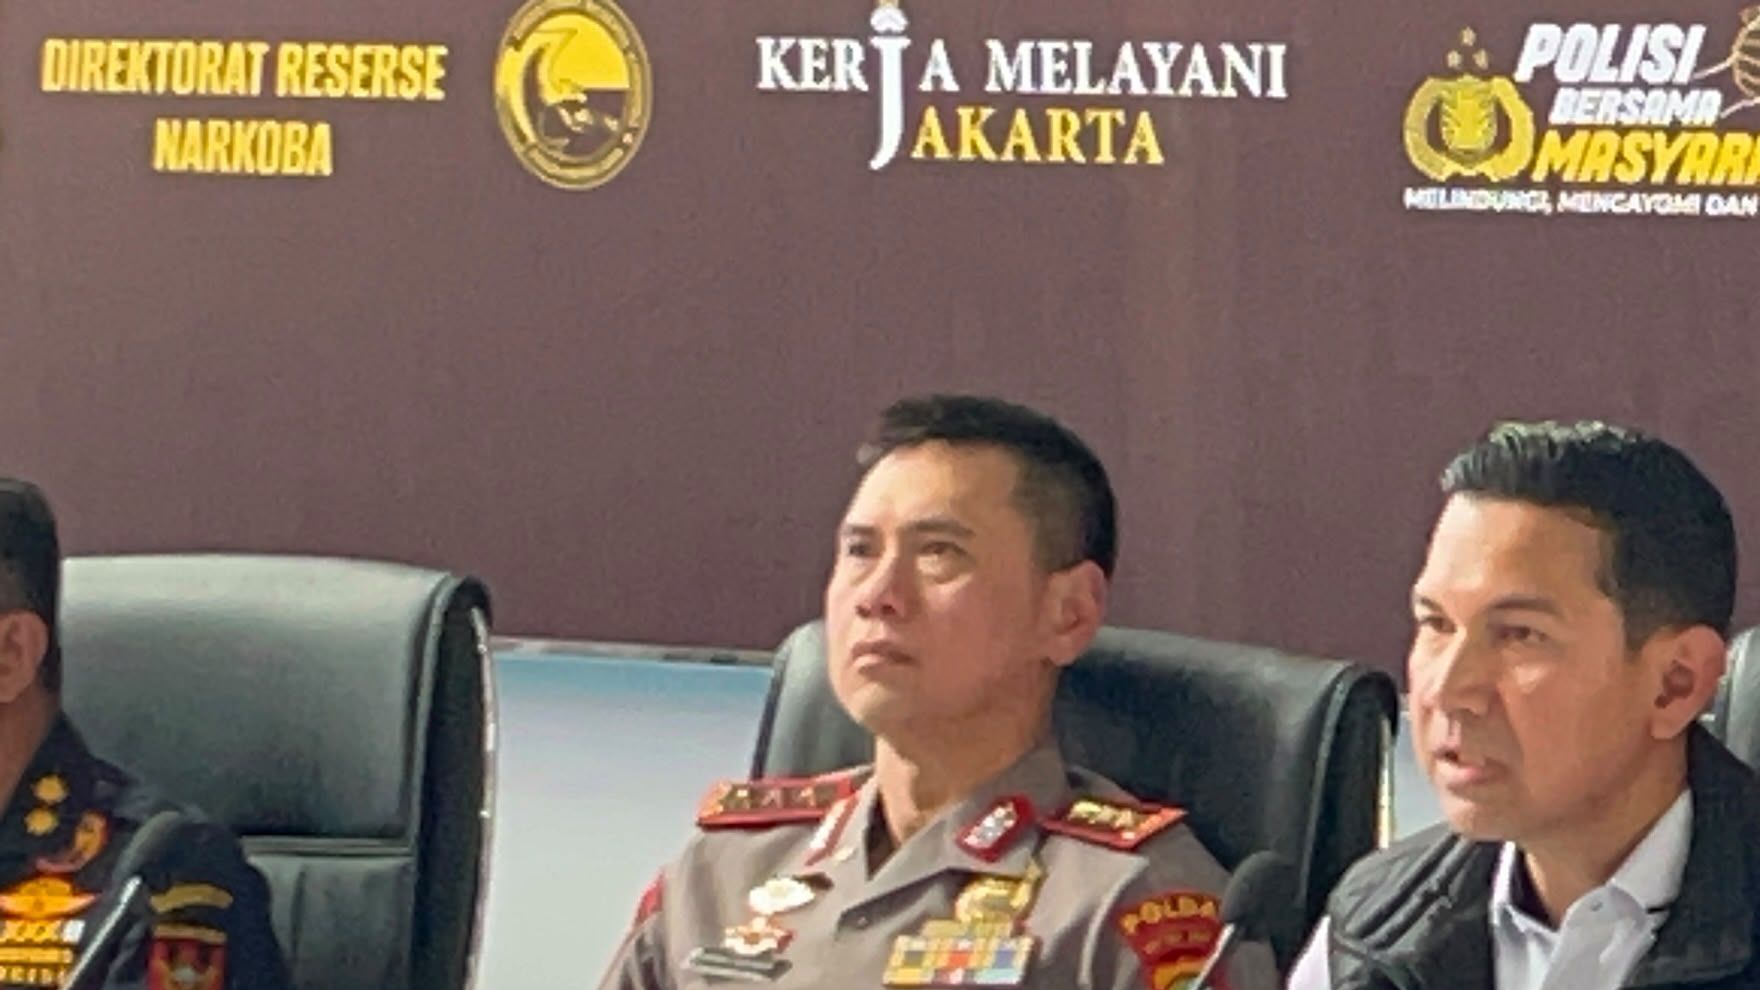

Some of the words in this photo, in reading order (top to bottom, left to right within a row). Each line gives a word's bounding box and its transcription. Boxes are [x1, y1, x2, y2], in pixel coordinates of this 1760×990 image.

[41, 39, 270, 93] DIREKTORAT
[276, 42, 449, 101] RESERSE
[985, 39, 1288, 98] MELAYANI
[1515, 23, 1705, 82] POLISI
[1549, 89, 1723, 126] BERSAMA
[153, 118, 333, 176] NARKOBA
[1704, 194, 1759, 216] DAN
[1120, 895, 1217, 935] POLDA
